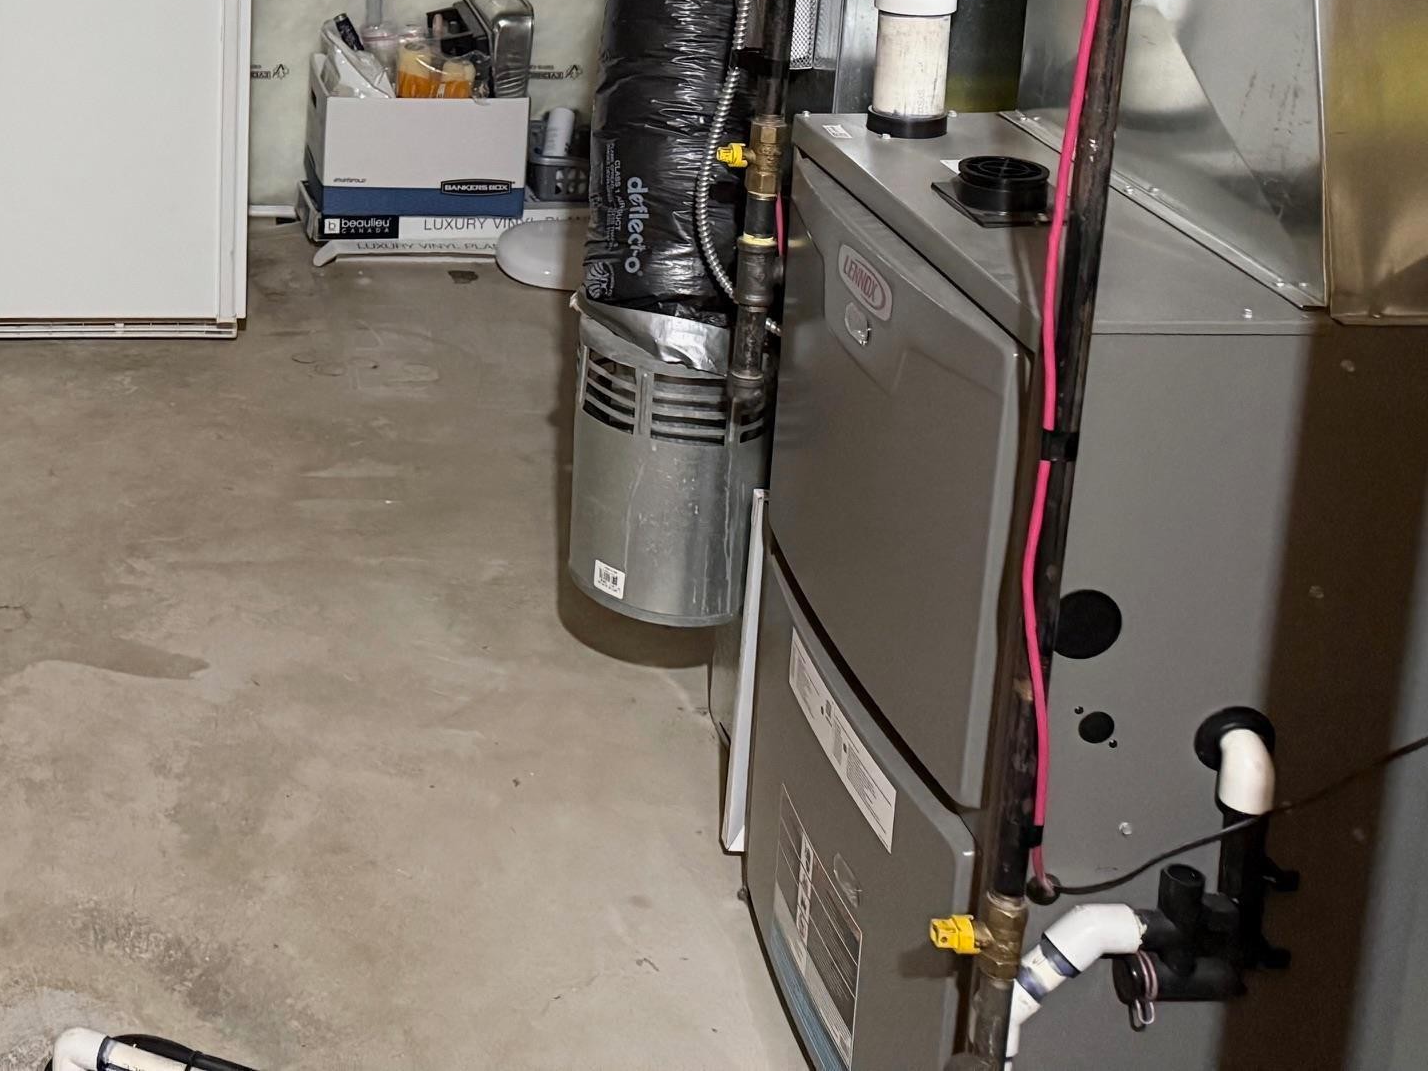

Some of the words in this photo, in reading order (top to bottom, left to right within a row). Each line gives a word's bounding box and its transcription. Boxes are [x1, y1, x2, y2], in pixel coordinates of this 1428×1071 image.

[341, 217, 390, 228] beaulieu
[424, 217, 486, 230] LUXURY
[624, 176, 650, 274] deflect-o
[357, 241, 414, 250] LUXURY
[421, 241, 460, 250] VINYL
[842, 254, 879, 303] LENNOX
